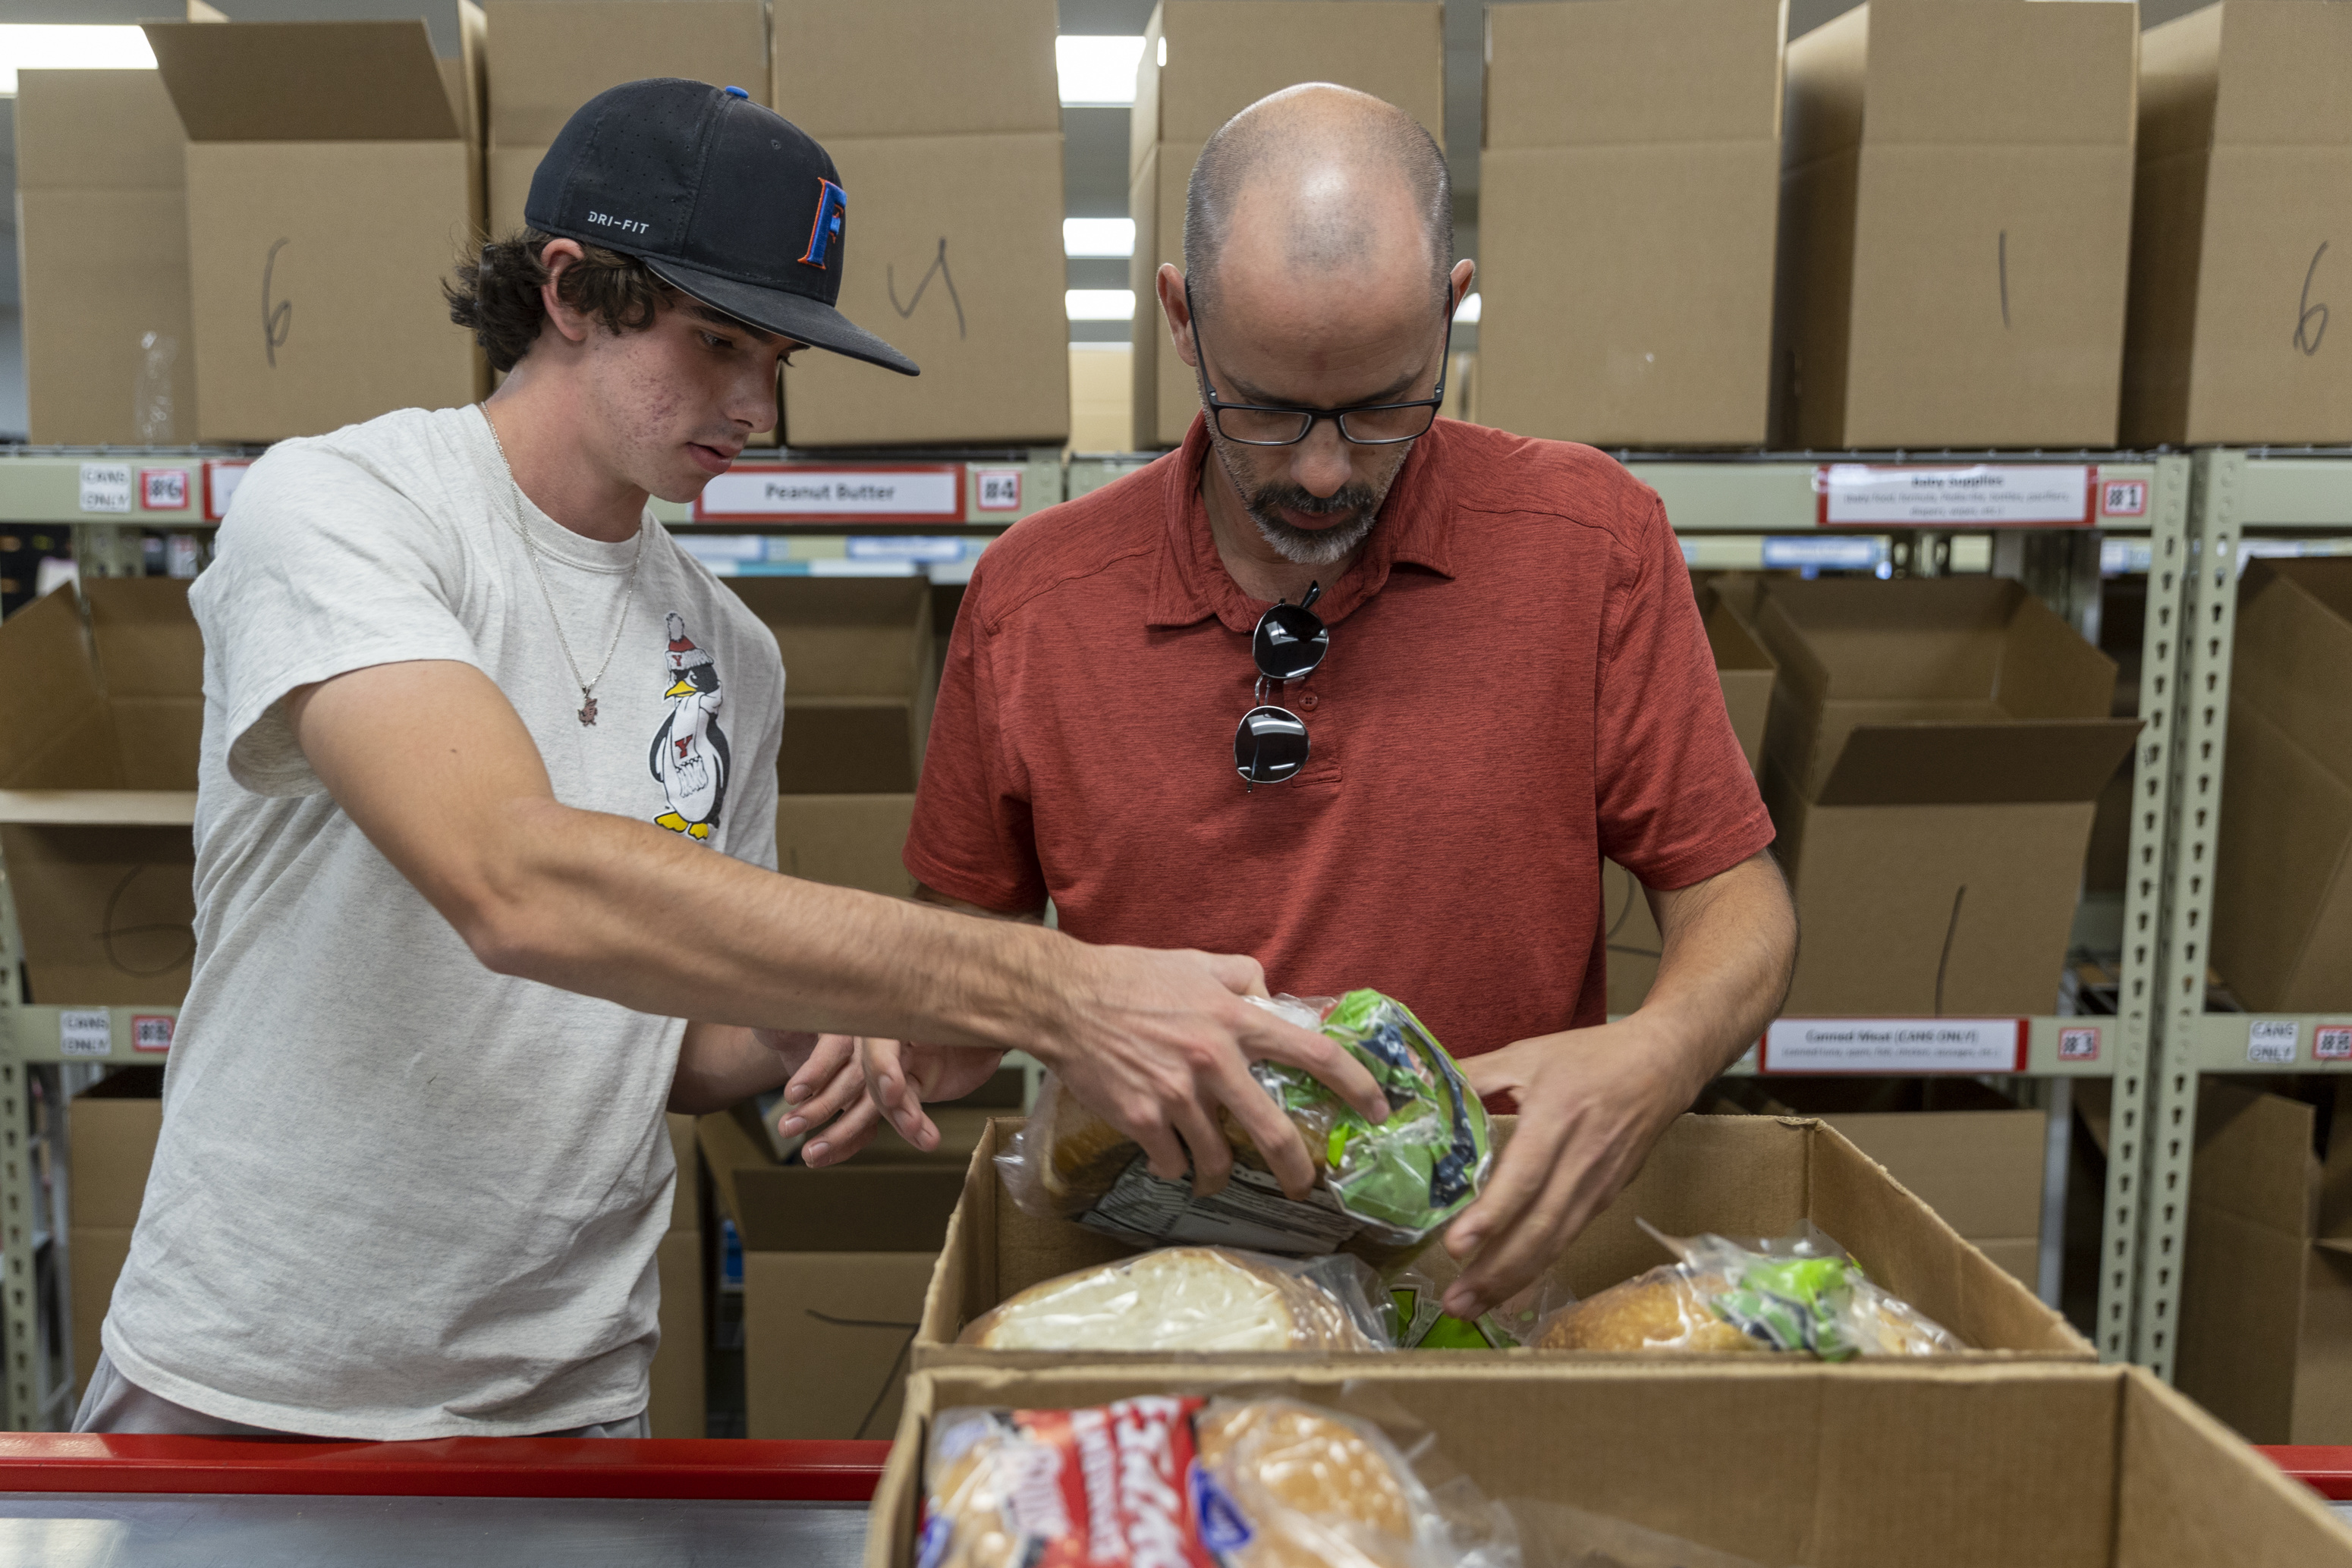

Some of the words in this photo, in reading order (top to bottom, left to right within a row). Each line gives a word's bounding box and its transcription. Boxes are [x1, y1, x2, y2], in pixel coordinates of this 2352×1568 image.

[587, 210, 650, 234] DRI-FIT
[797, 176, 848, 271] F
[260, 236, 293, 369] 6
[2293, 240, 2329, 357] 6
[150, 476, 184, 499] #6
[765, 482, 831, 501] Peanut
[836, 482, 895, 501] Butter
[986, 479, 1014, 501] #4
[2108, 485, 2139, 509] #1
[672, 654, 682, 666] Y
[674, 734, 693, 759] Y
[1806, 1028, 1854, 1043] Canned
[1858, 1029, 1891, 1043] Meat
[1895, 1028, 1934, 1044] (CANS
[1937, 1028, 1979, 1044] ONLY)
[2251, 1021, 2293, 1038] CANS
[2250, 1044, 2291, 1061] ONLY
